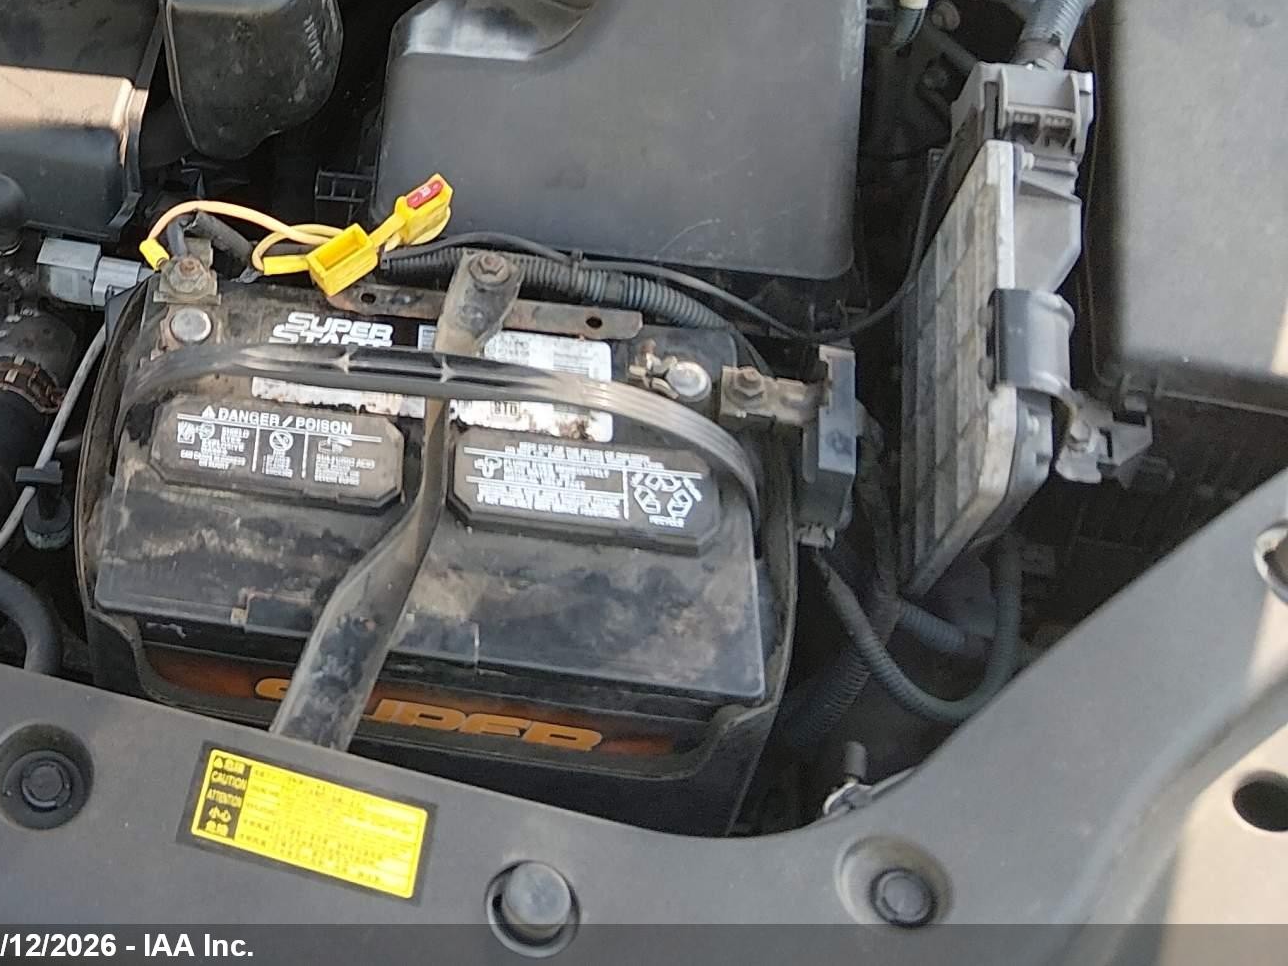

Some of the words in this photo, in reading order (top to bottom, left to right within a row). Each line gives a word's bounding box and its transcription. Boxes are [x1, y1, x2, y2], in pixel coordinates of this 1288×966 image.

[285, 311, 393, 340] SUPER
[217, 407, 281, 428] DANGER
[295, 416, 353, 435] POISON
[210, 770, 248, 791] CAUTION
